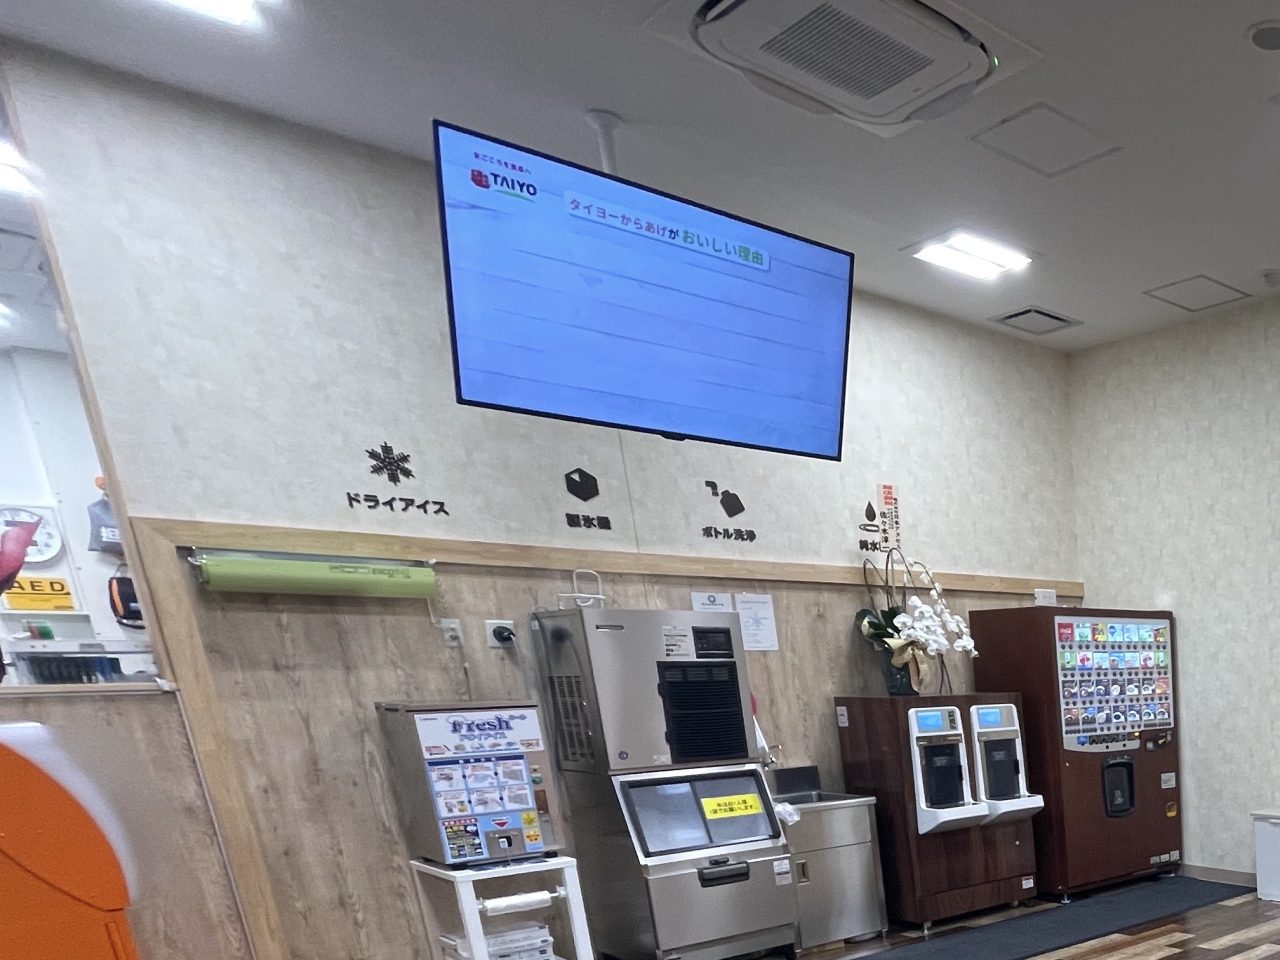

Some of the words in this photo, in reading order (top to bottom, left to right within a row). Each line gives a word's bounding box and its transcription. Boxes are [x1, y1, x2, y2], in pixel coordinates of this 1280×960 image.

[490, 172, 537, 196] TAIYO
[346, 491, 450, 516] ドライアイス
[9, 580, 66, 593] AED
[451, 714, 513, 734] Fresh
